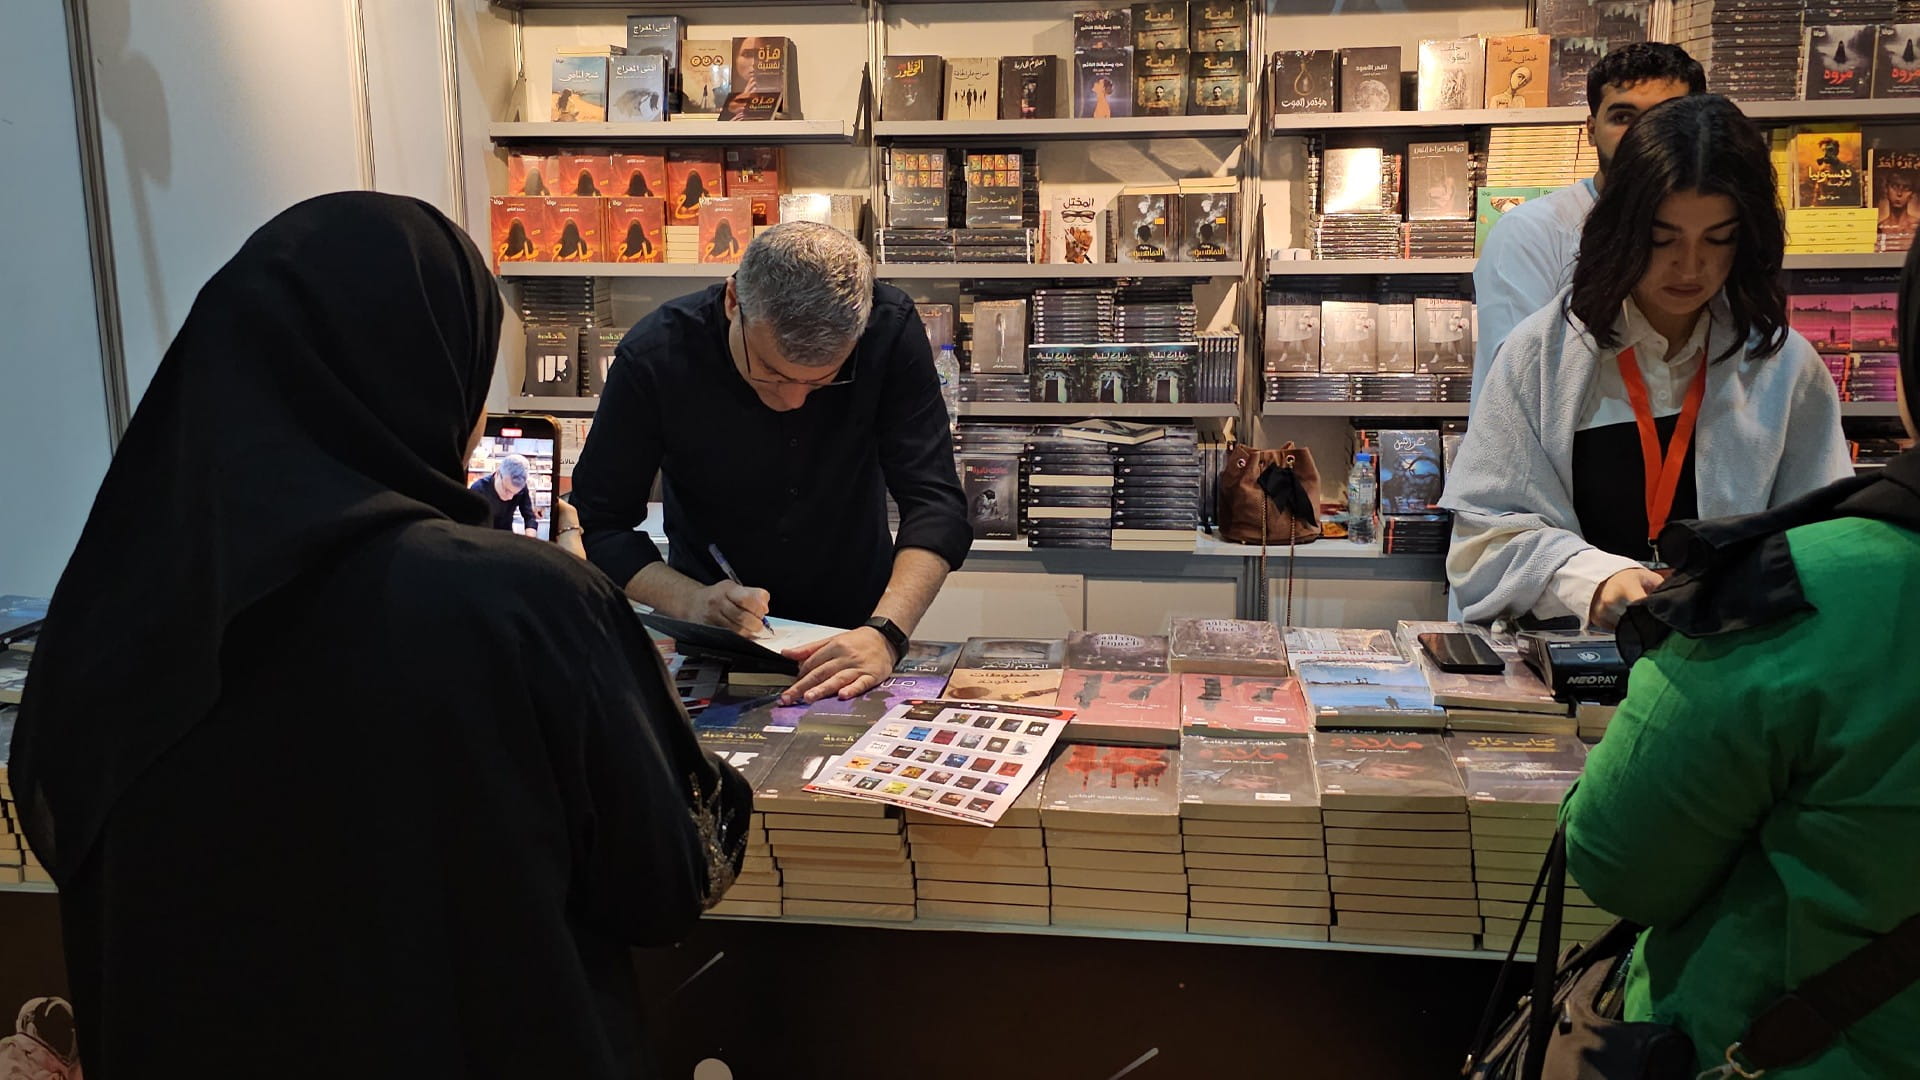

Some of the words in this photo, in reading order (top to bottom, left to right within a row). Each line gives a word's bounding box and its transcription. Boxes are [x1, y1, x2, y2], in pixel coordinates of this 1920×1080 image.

[1281, 98, 1304, 109] الموت
[1808, 165, 1852, 183] ديستوبيا
[1063, 197, 1094, 209] المختل
